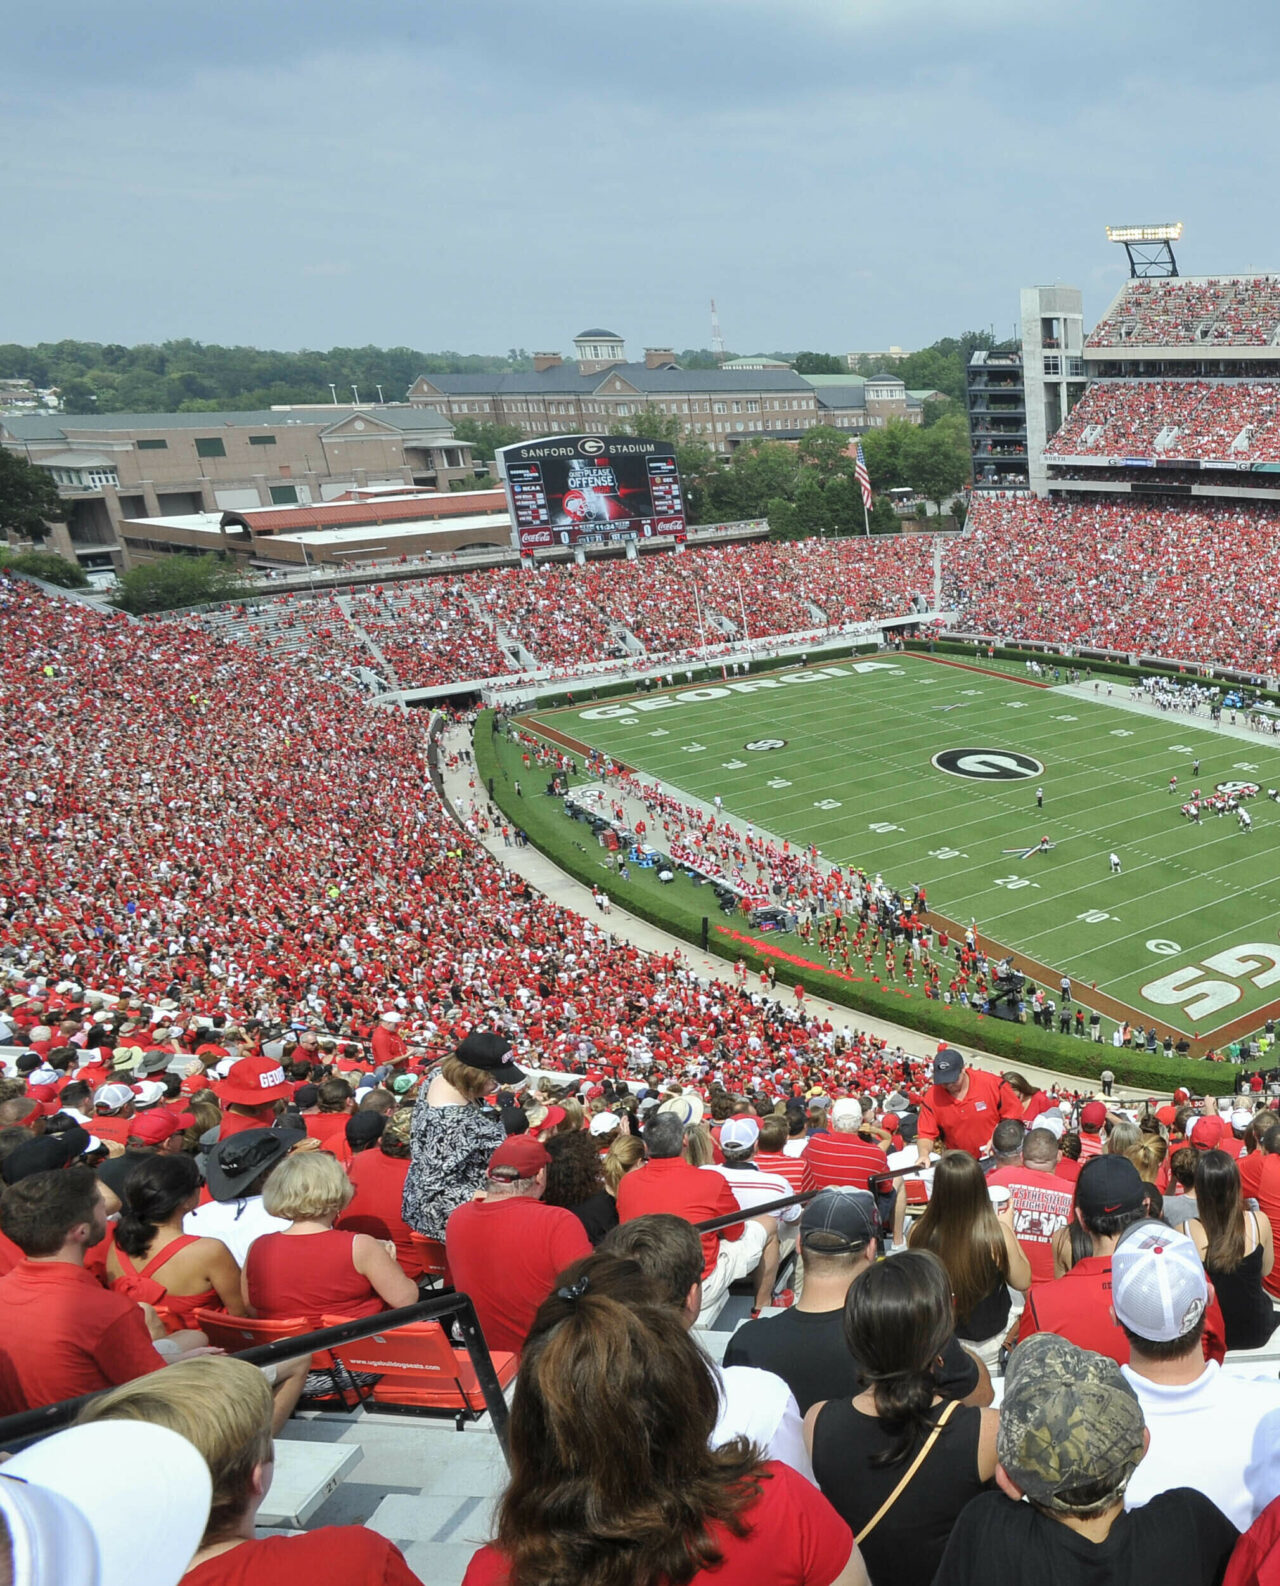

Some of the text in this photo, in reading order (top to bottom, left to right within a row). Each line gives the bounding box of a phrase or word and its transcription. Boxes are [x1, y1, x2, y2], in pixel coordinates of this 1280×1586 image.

[521, 447, 575, 458] SANFORD
[609, 443, 655, 454] STADIUM
[584, 468, 611, 477] PLEASE
[568, 476, 614, 488] OFFENSE
[578, 661, 901, 720] GEORGIA
[868, 822, 897, 833] 40
[928, 847, 960, 860] 30
[993, 875, 1031, 890] 20
[1075, 909, 1110, 923] 10
[1145, 938, 1182, 955] G
